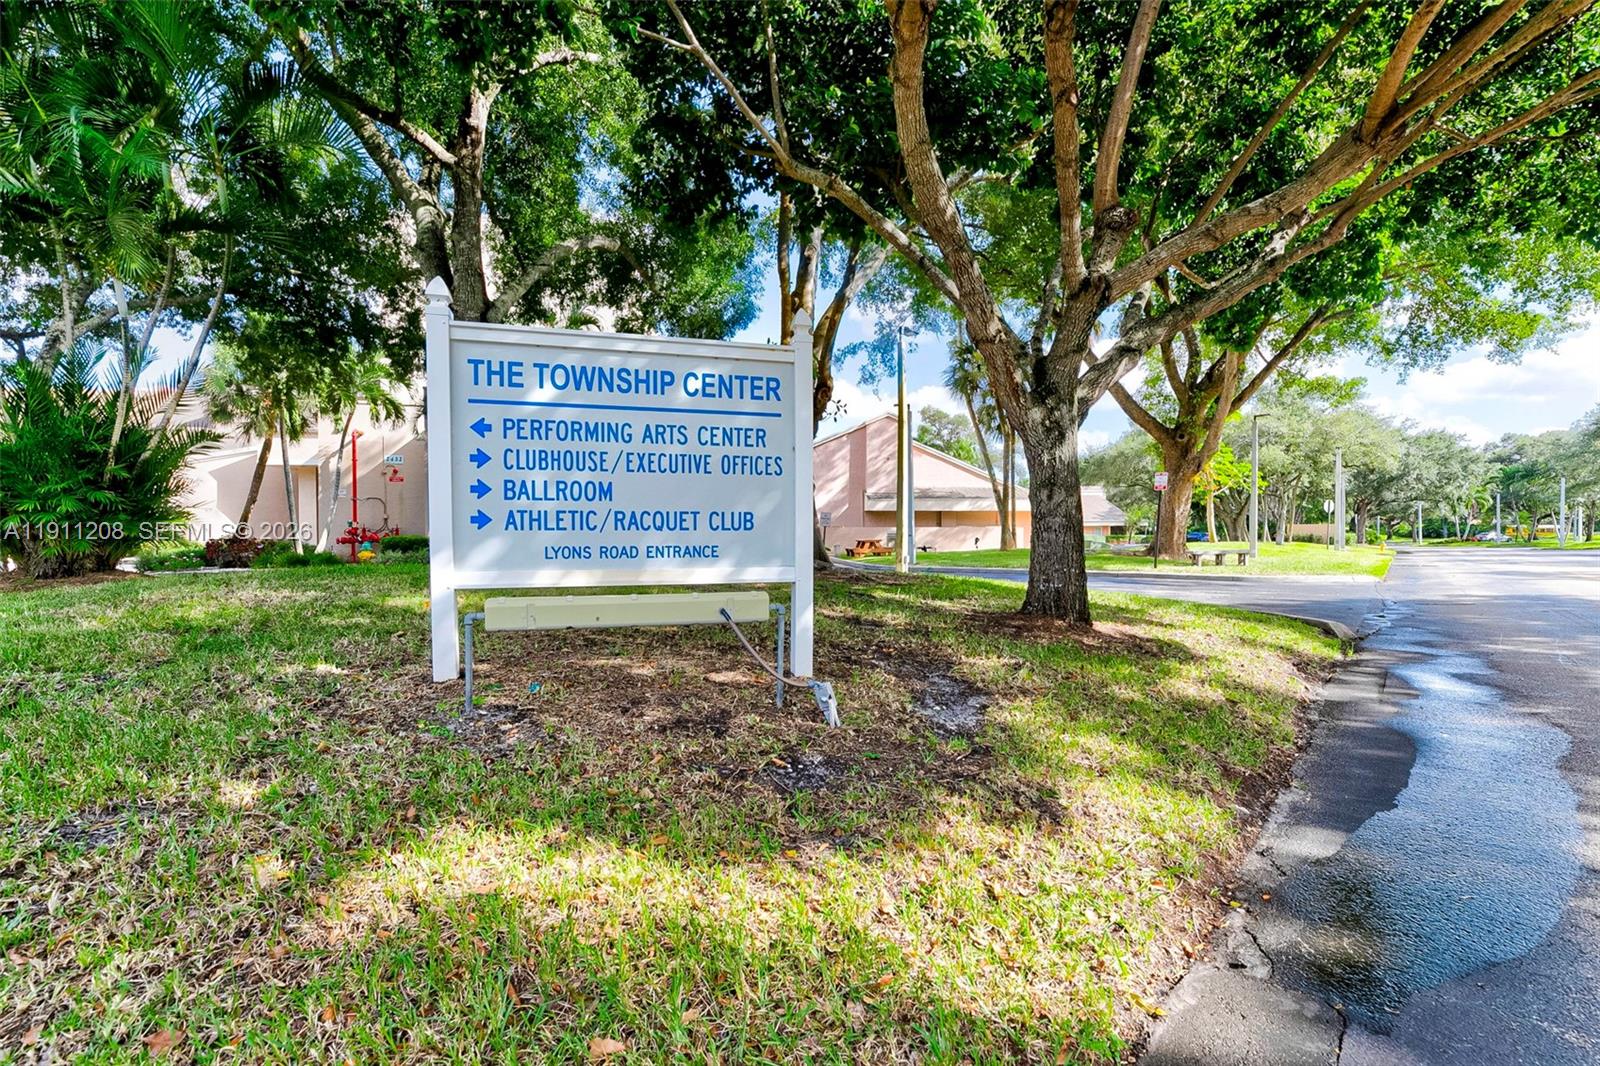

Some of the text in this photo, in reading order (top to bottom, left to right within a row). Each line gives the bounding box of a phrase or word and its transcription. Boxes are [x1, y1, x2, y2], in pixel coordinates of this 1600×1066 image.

[467, 358, 783, 402] THE TOWNSHIP CENTER
[502, 418, 767, 448] PERFORMING ARTS CENTER
[502, 448, 784, 477] CLUBHOUSE/EXECUTIVE OFFICES
[503, 480, 614, 502] BALLROOM
[504, 508, 755, 534] ATHLETIC/RACQUET CLUB
[544, 545, 720, 560] LYONS ROAD ENTRANCE
